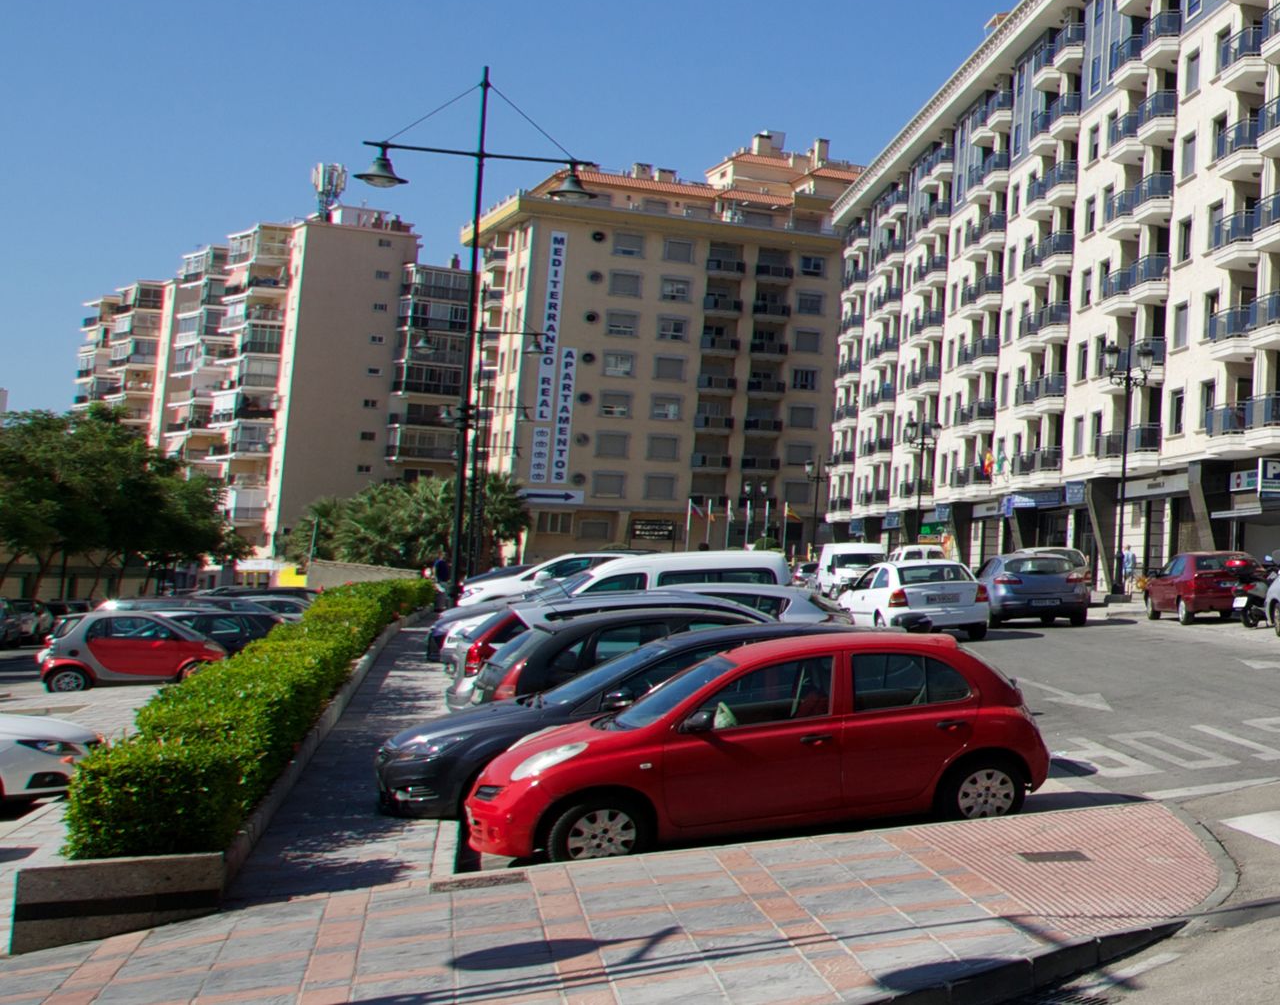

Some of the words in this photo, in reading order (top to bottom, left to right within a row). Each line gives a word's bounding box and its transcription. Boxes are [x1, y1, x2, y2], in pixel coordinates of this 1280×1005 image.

[543, 236, 565, 366] MEDITERRANEO
[539, 376, 552, 419] REAL
[554, 350, 575, 481] APARTAMENTOS
